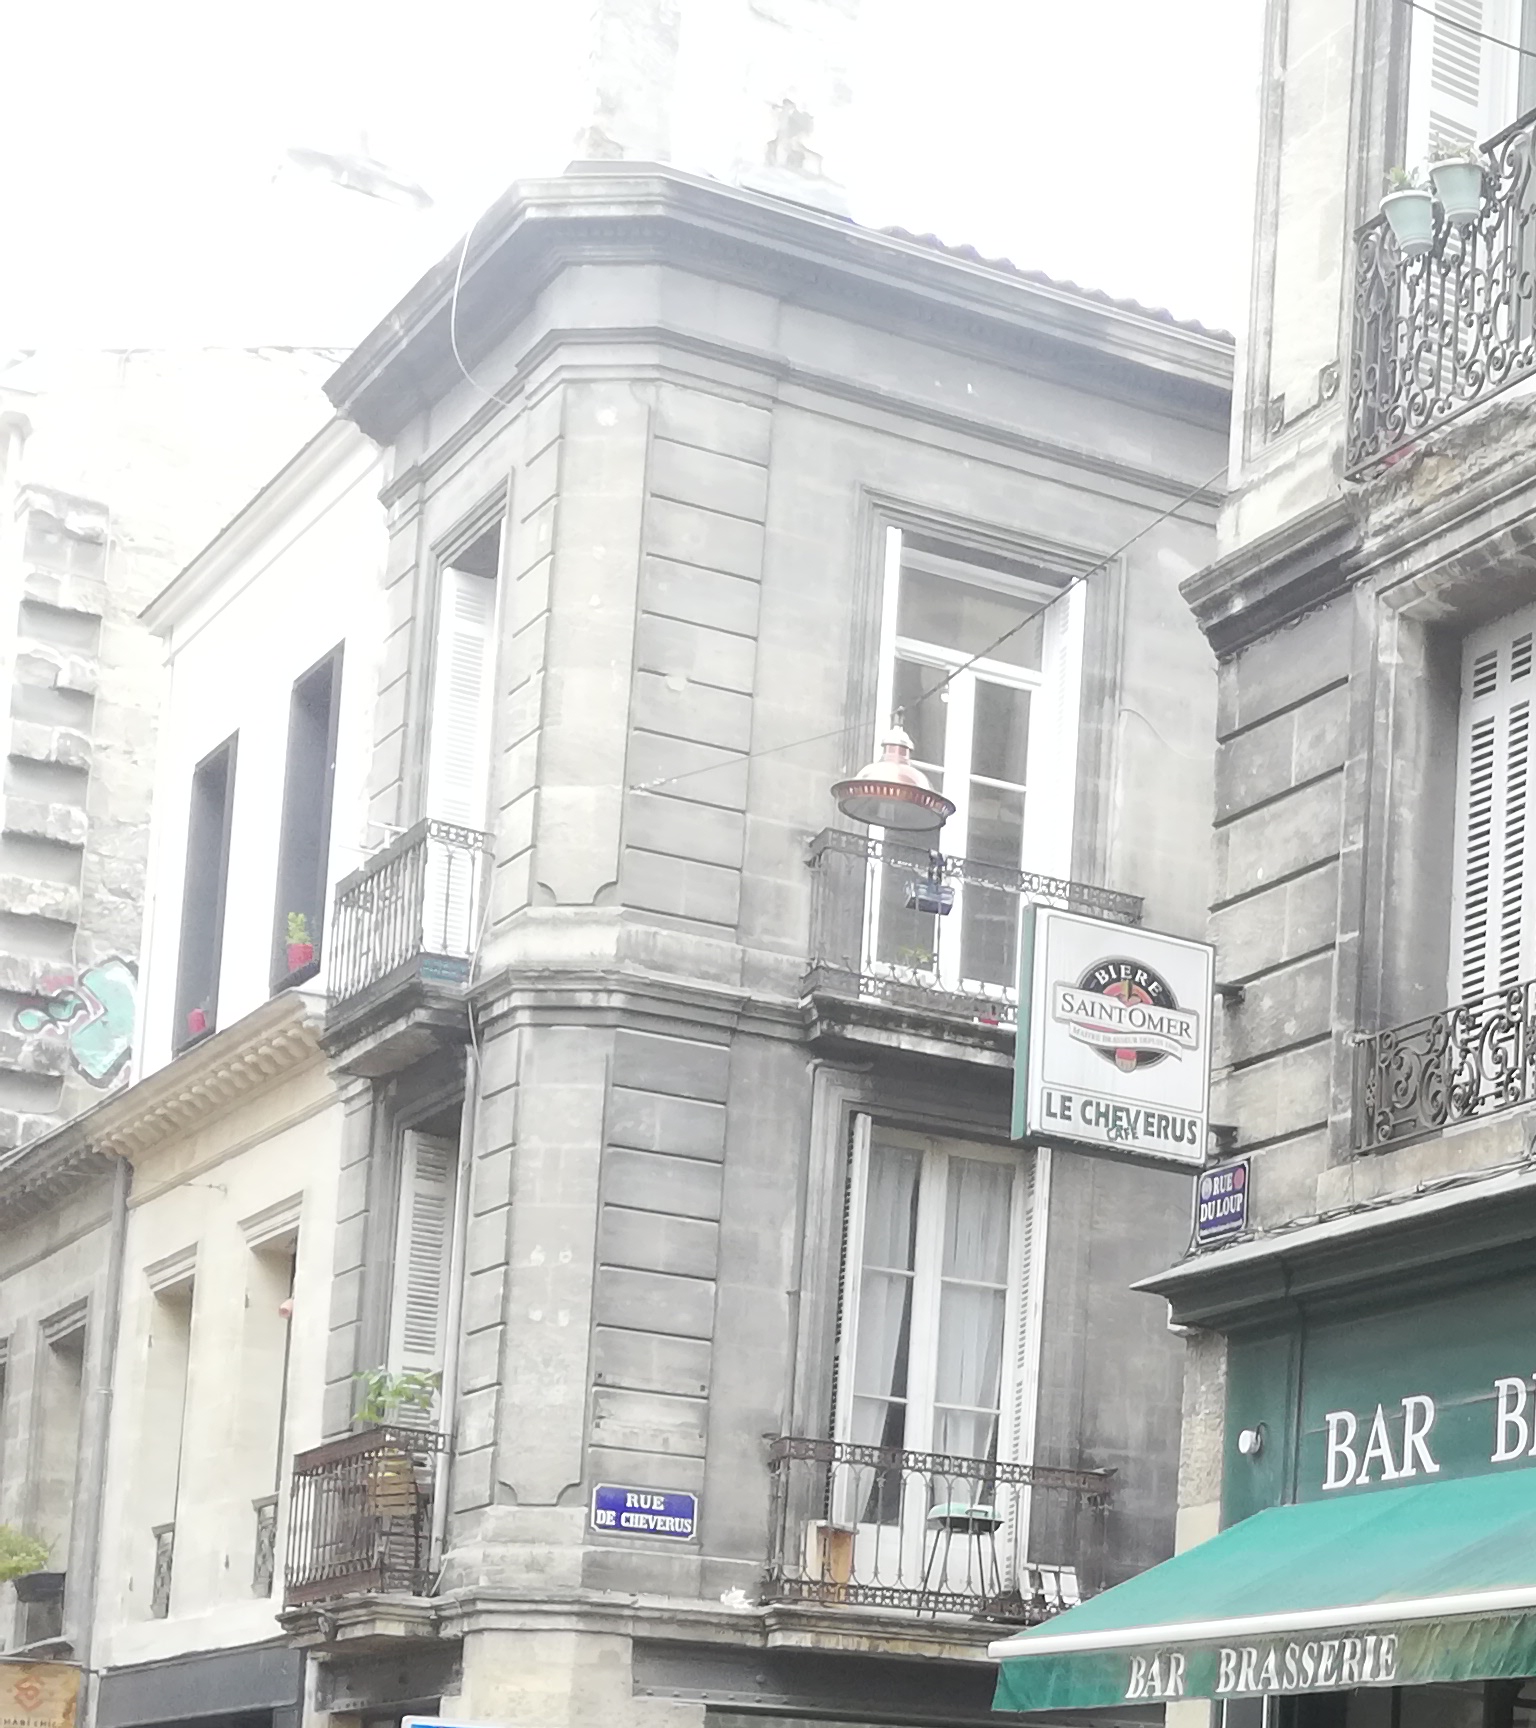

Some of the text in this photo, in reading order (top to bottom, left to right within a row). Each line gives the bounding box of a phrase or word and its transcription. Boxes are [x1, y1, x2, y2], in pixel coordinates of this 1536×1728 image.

[1095, 965, 1163, 997] BIERE
[1046, 1092, 1197, 1145] LE CHEVERUS
[1213, 1173, 1233, 1196] RUE
[1200, 1193, 1243, 1222] DU LOUP
[1322, 1395, 1439, 1490] BAR
[626, 1493, 665, 1510] RUE
[596, 1510, 692, 1533] DE CHEVERUS
[1125, 1633, 1400, 1699] BAR BRASSERIE
